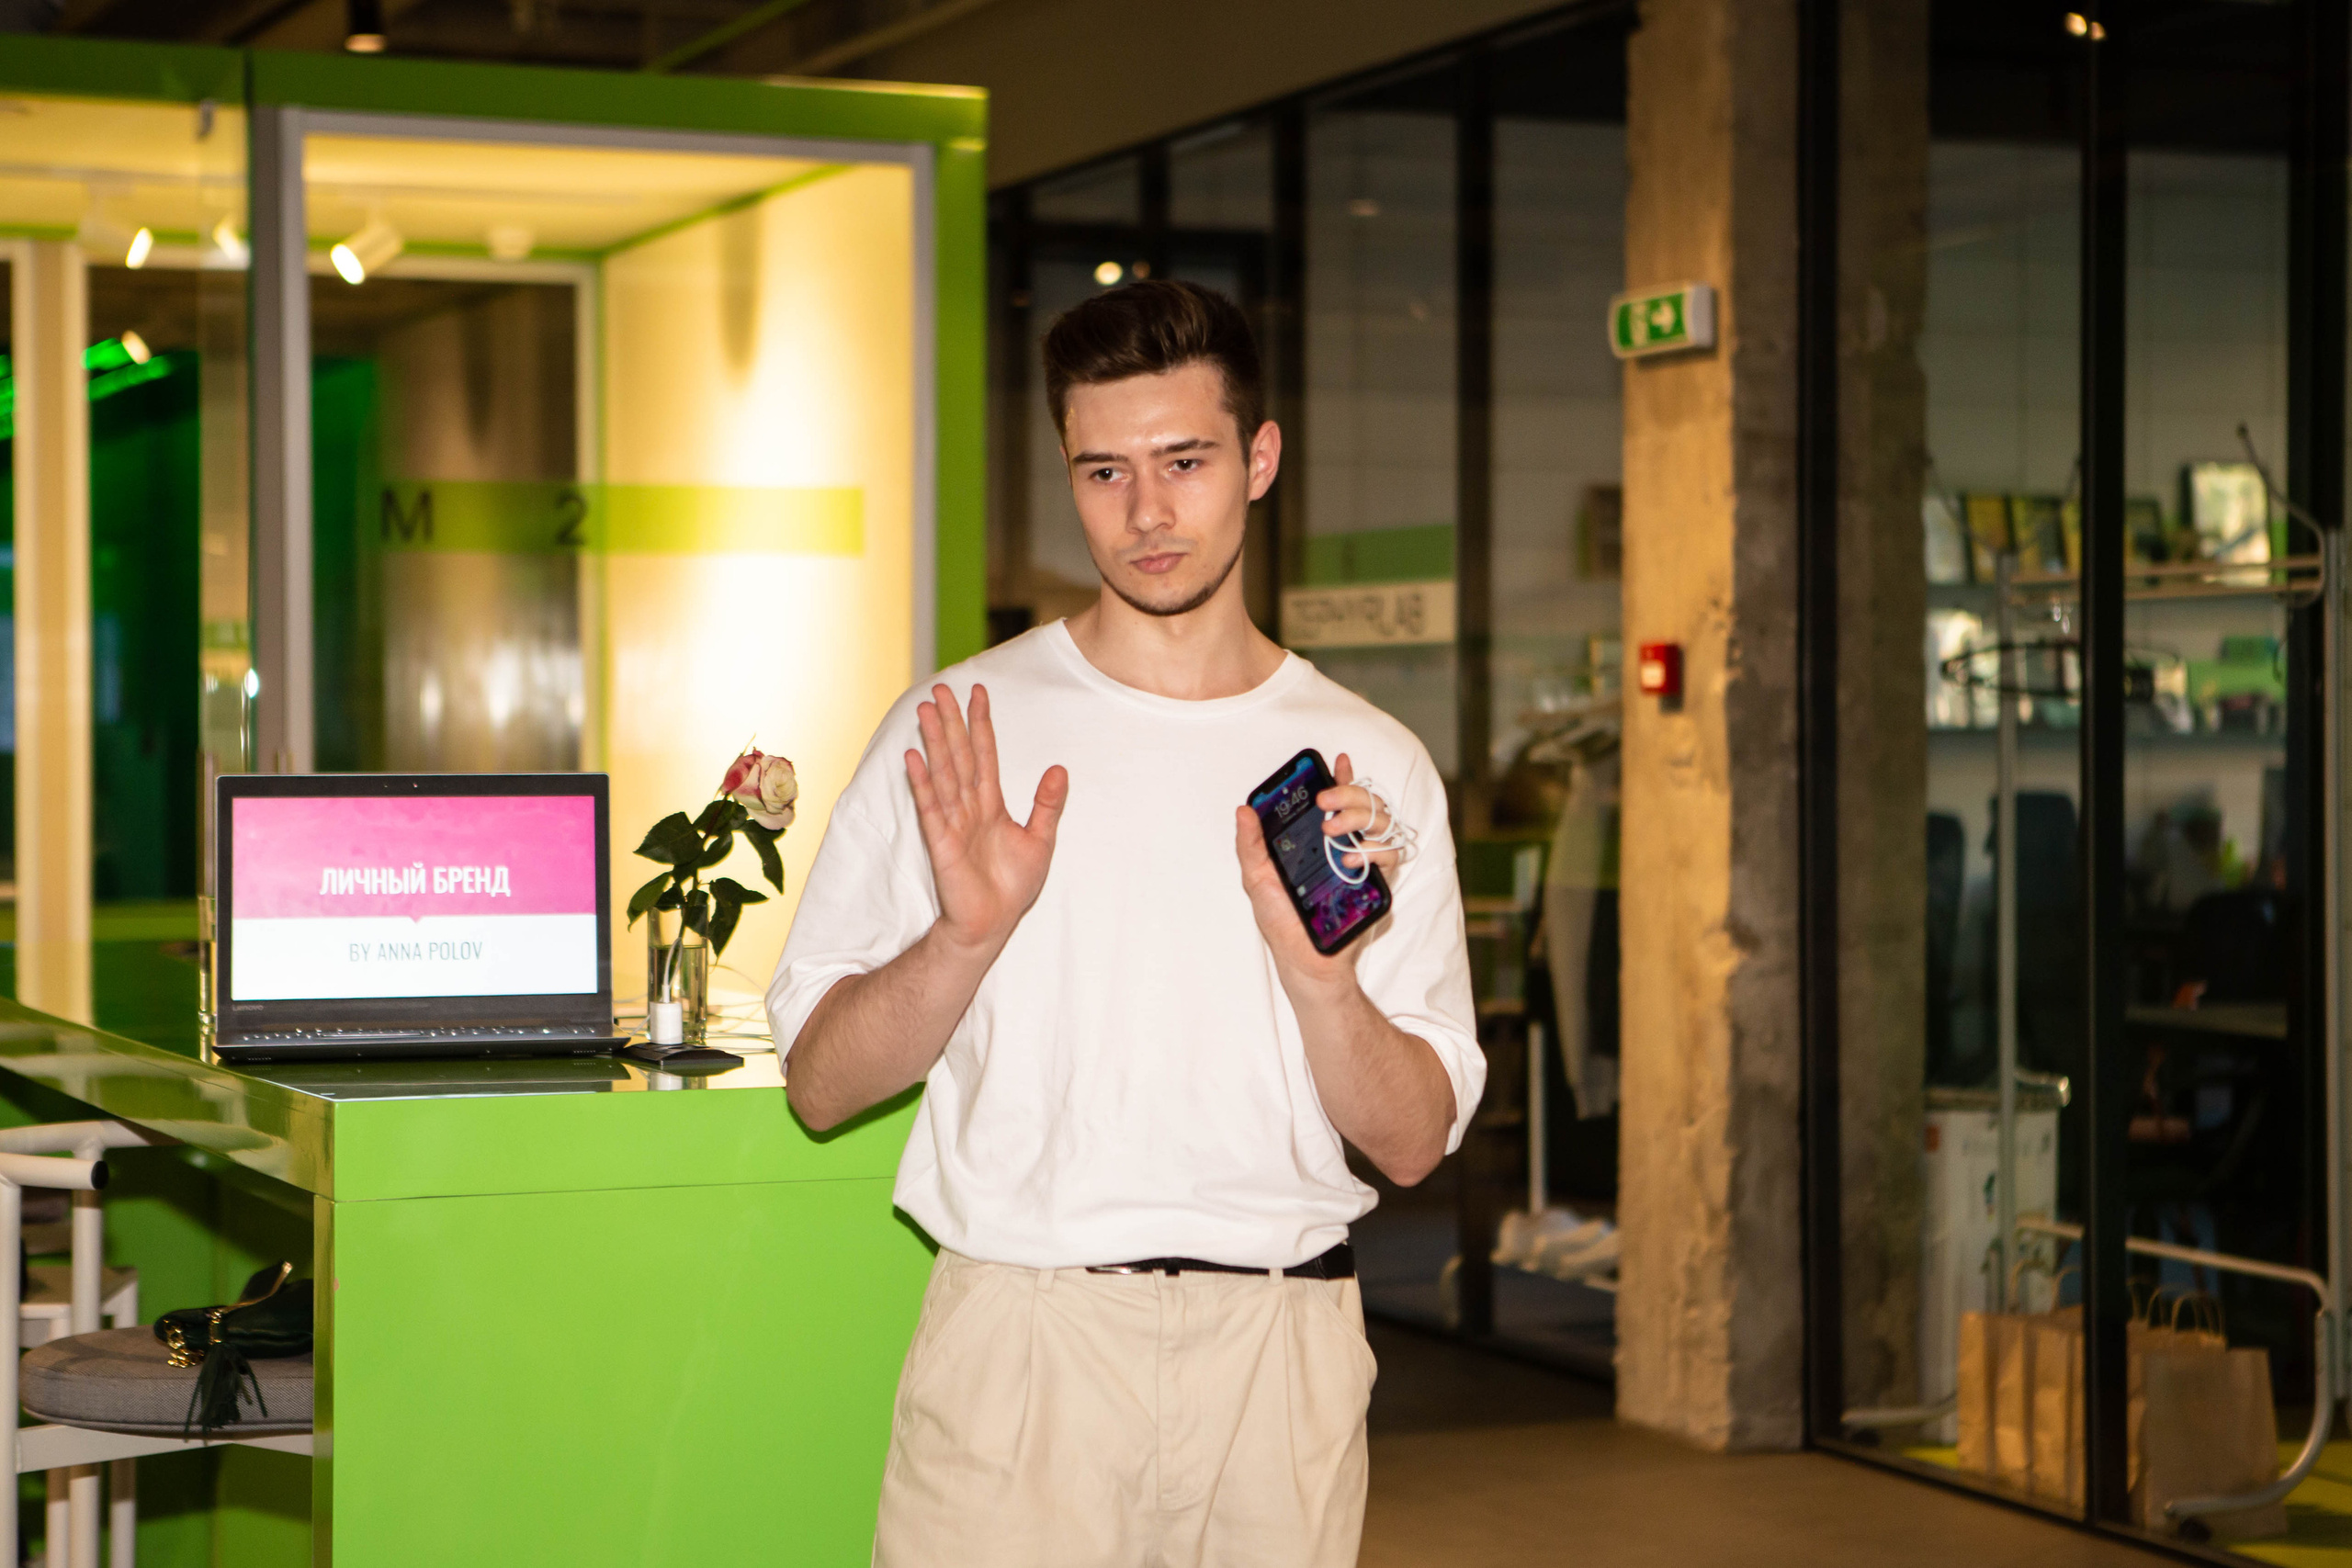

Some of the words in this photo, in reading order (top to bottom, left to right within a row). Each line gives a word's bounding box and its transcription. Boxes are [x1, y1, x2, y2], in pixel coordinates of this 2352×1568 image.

[380, 490, 433, 540] M
[555, 489, 587, 546] 2
[1274, 785, 1308, 818] 19:46
[320, 862, 425, 895] ЛИЧНЫЙ
[433, 867, 511, 897] БРЕНД
[349, 942, 370, 962] BY
[378, 942, 422, 961] ANNA
[429, 942, 482, 961] POLOV
